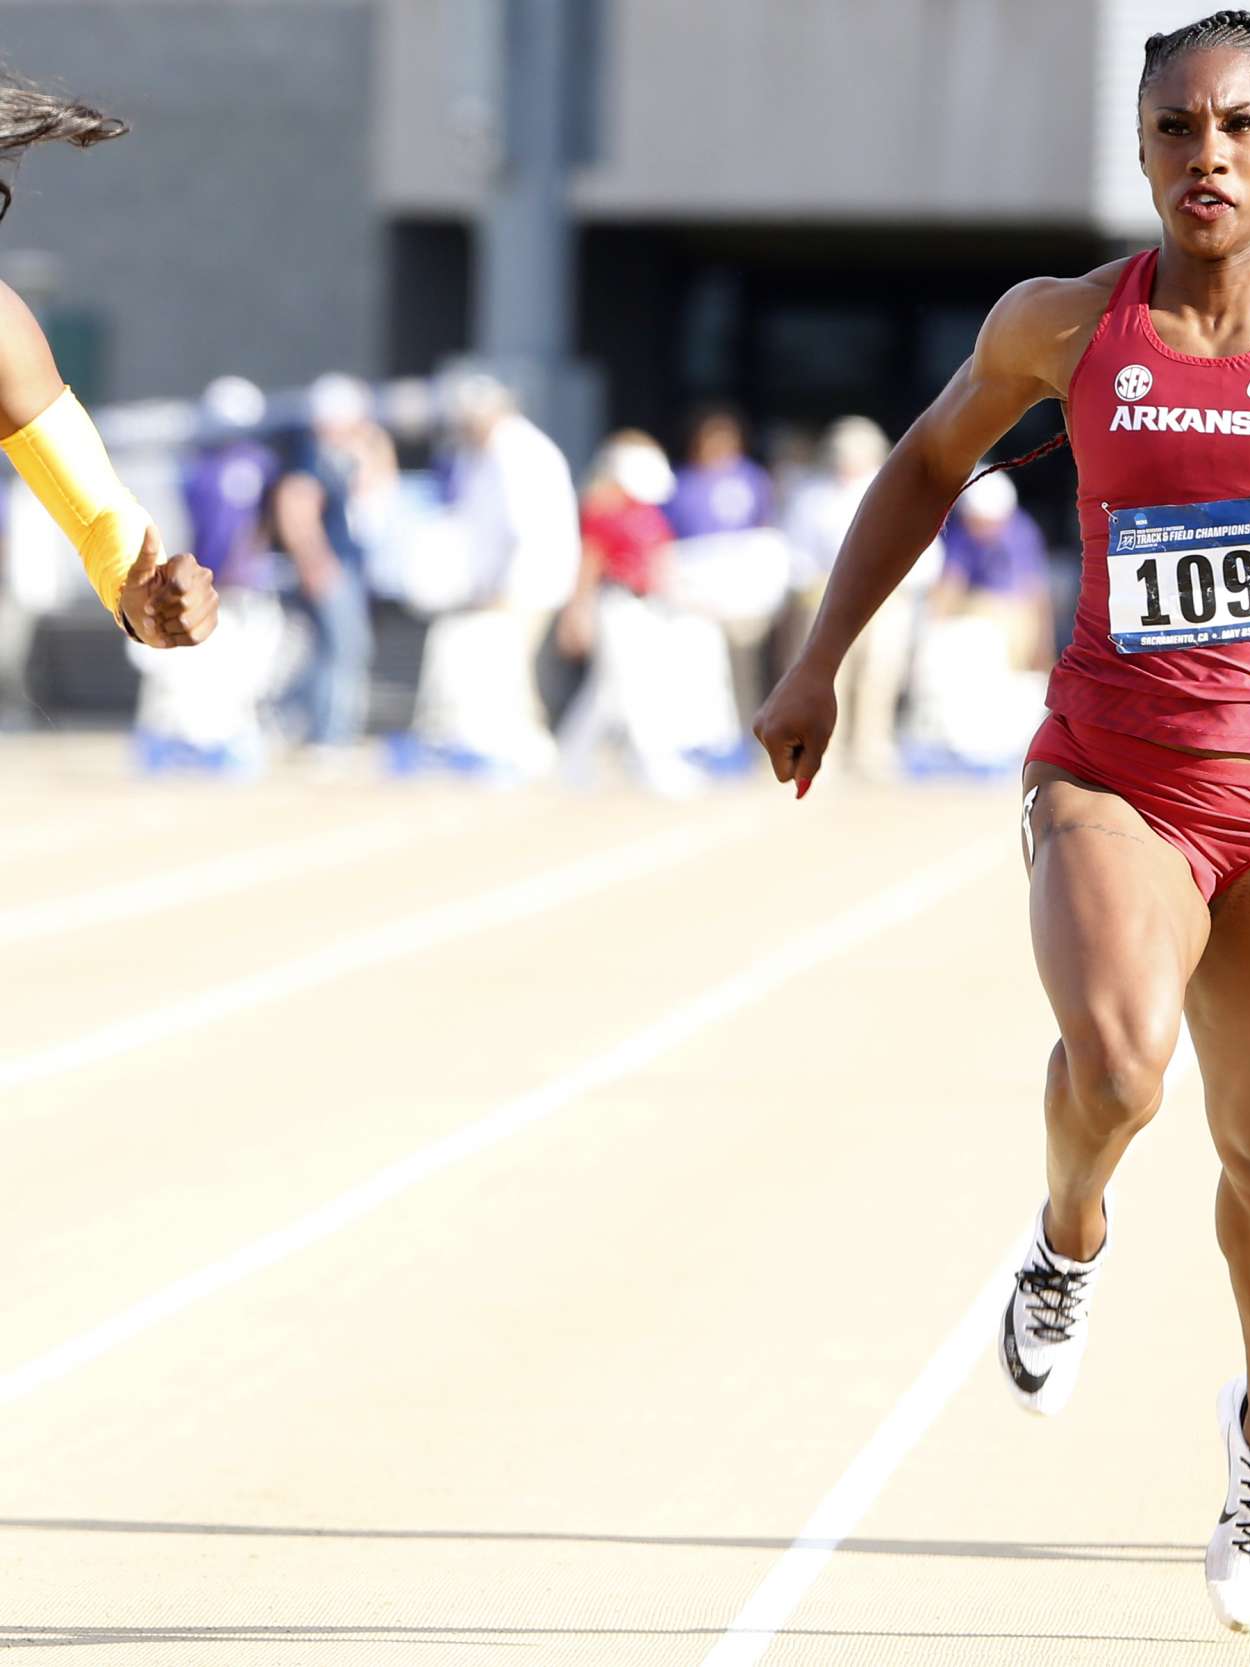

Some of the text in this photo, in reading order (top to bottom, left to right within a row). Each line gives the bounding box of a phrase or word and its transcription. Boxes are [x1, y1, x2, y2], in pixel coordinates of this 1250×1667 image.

[1117, 367, 1150, 399] SEC
[1136, 532, 1162, 545] TRACK
[1169, 529, 1194, 542] FIELD
[1197, 632, 1209, 642] CA
[1221, 629, 1241, 639] MAY
